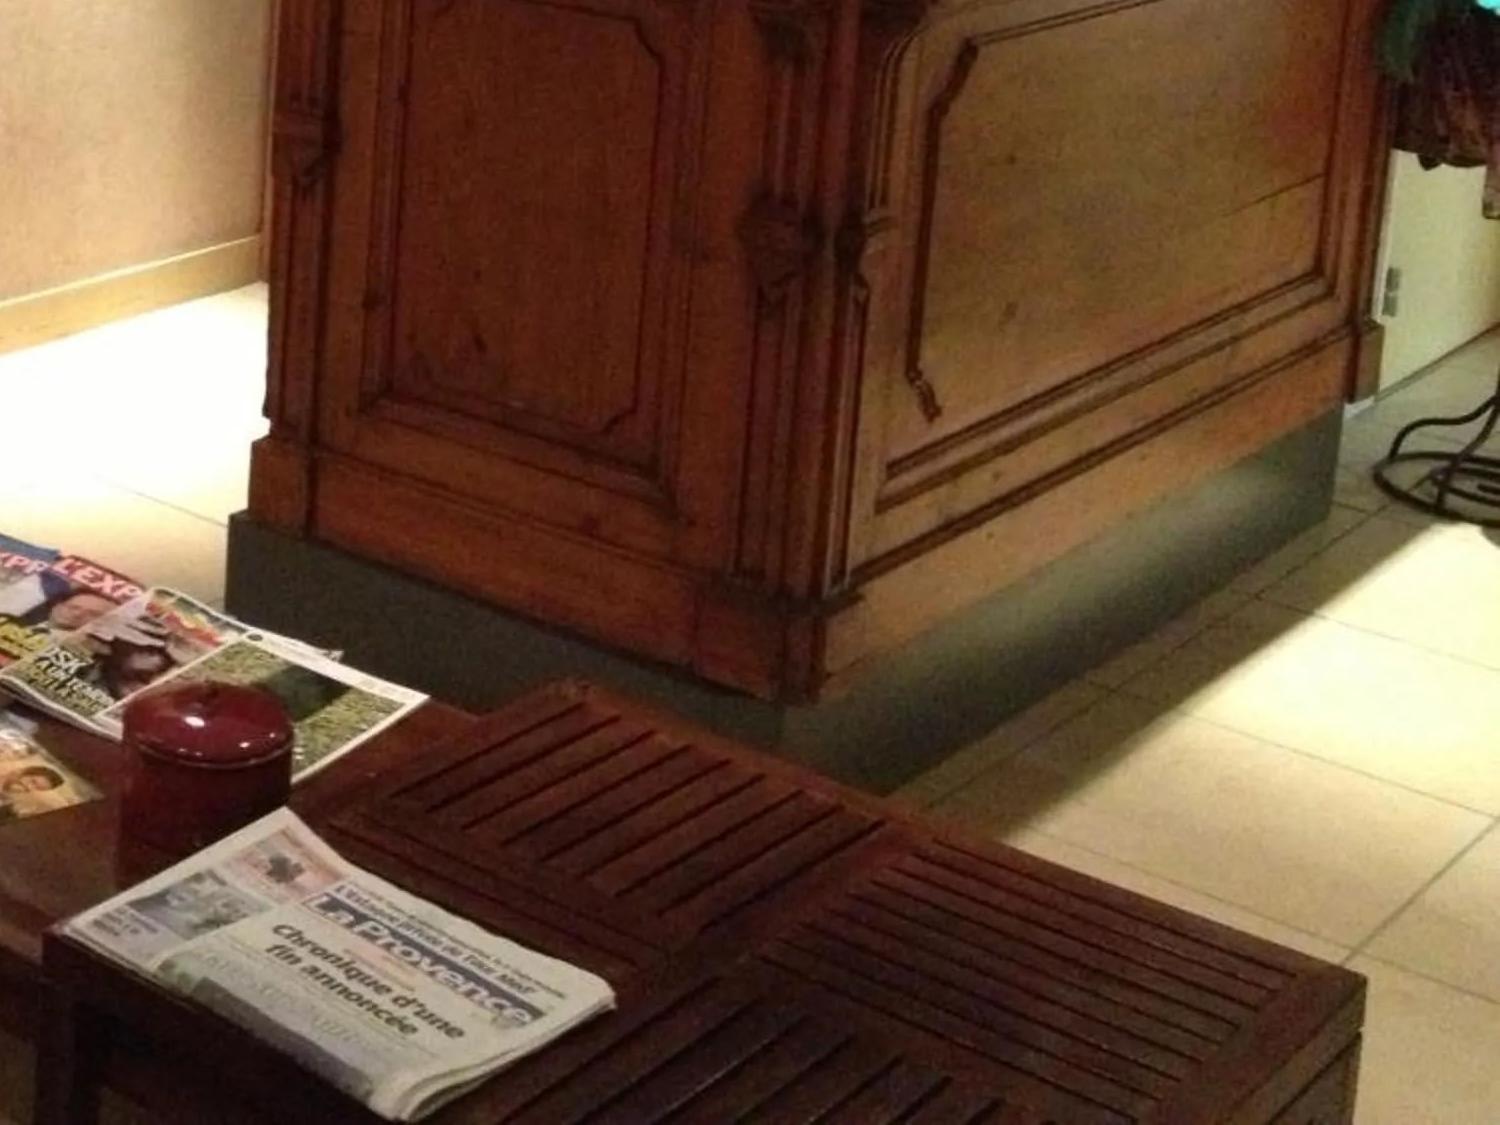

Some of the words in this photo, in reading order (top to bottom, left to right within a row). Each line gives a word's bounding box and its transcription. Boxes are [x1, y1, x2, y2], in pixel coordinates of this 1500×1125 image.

[266, 944, 303, 966] fin
[301, 964, 418, 1035] annoncée
[272, 924, 393, 995] Chronique
[392, 996, 465, 1039] d'une
[310, 895, 355, 925] La
[354, 921, 532, 1024] Provence
